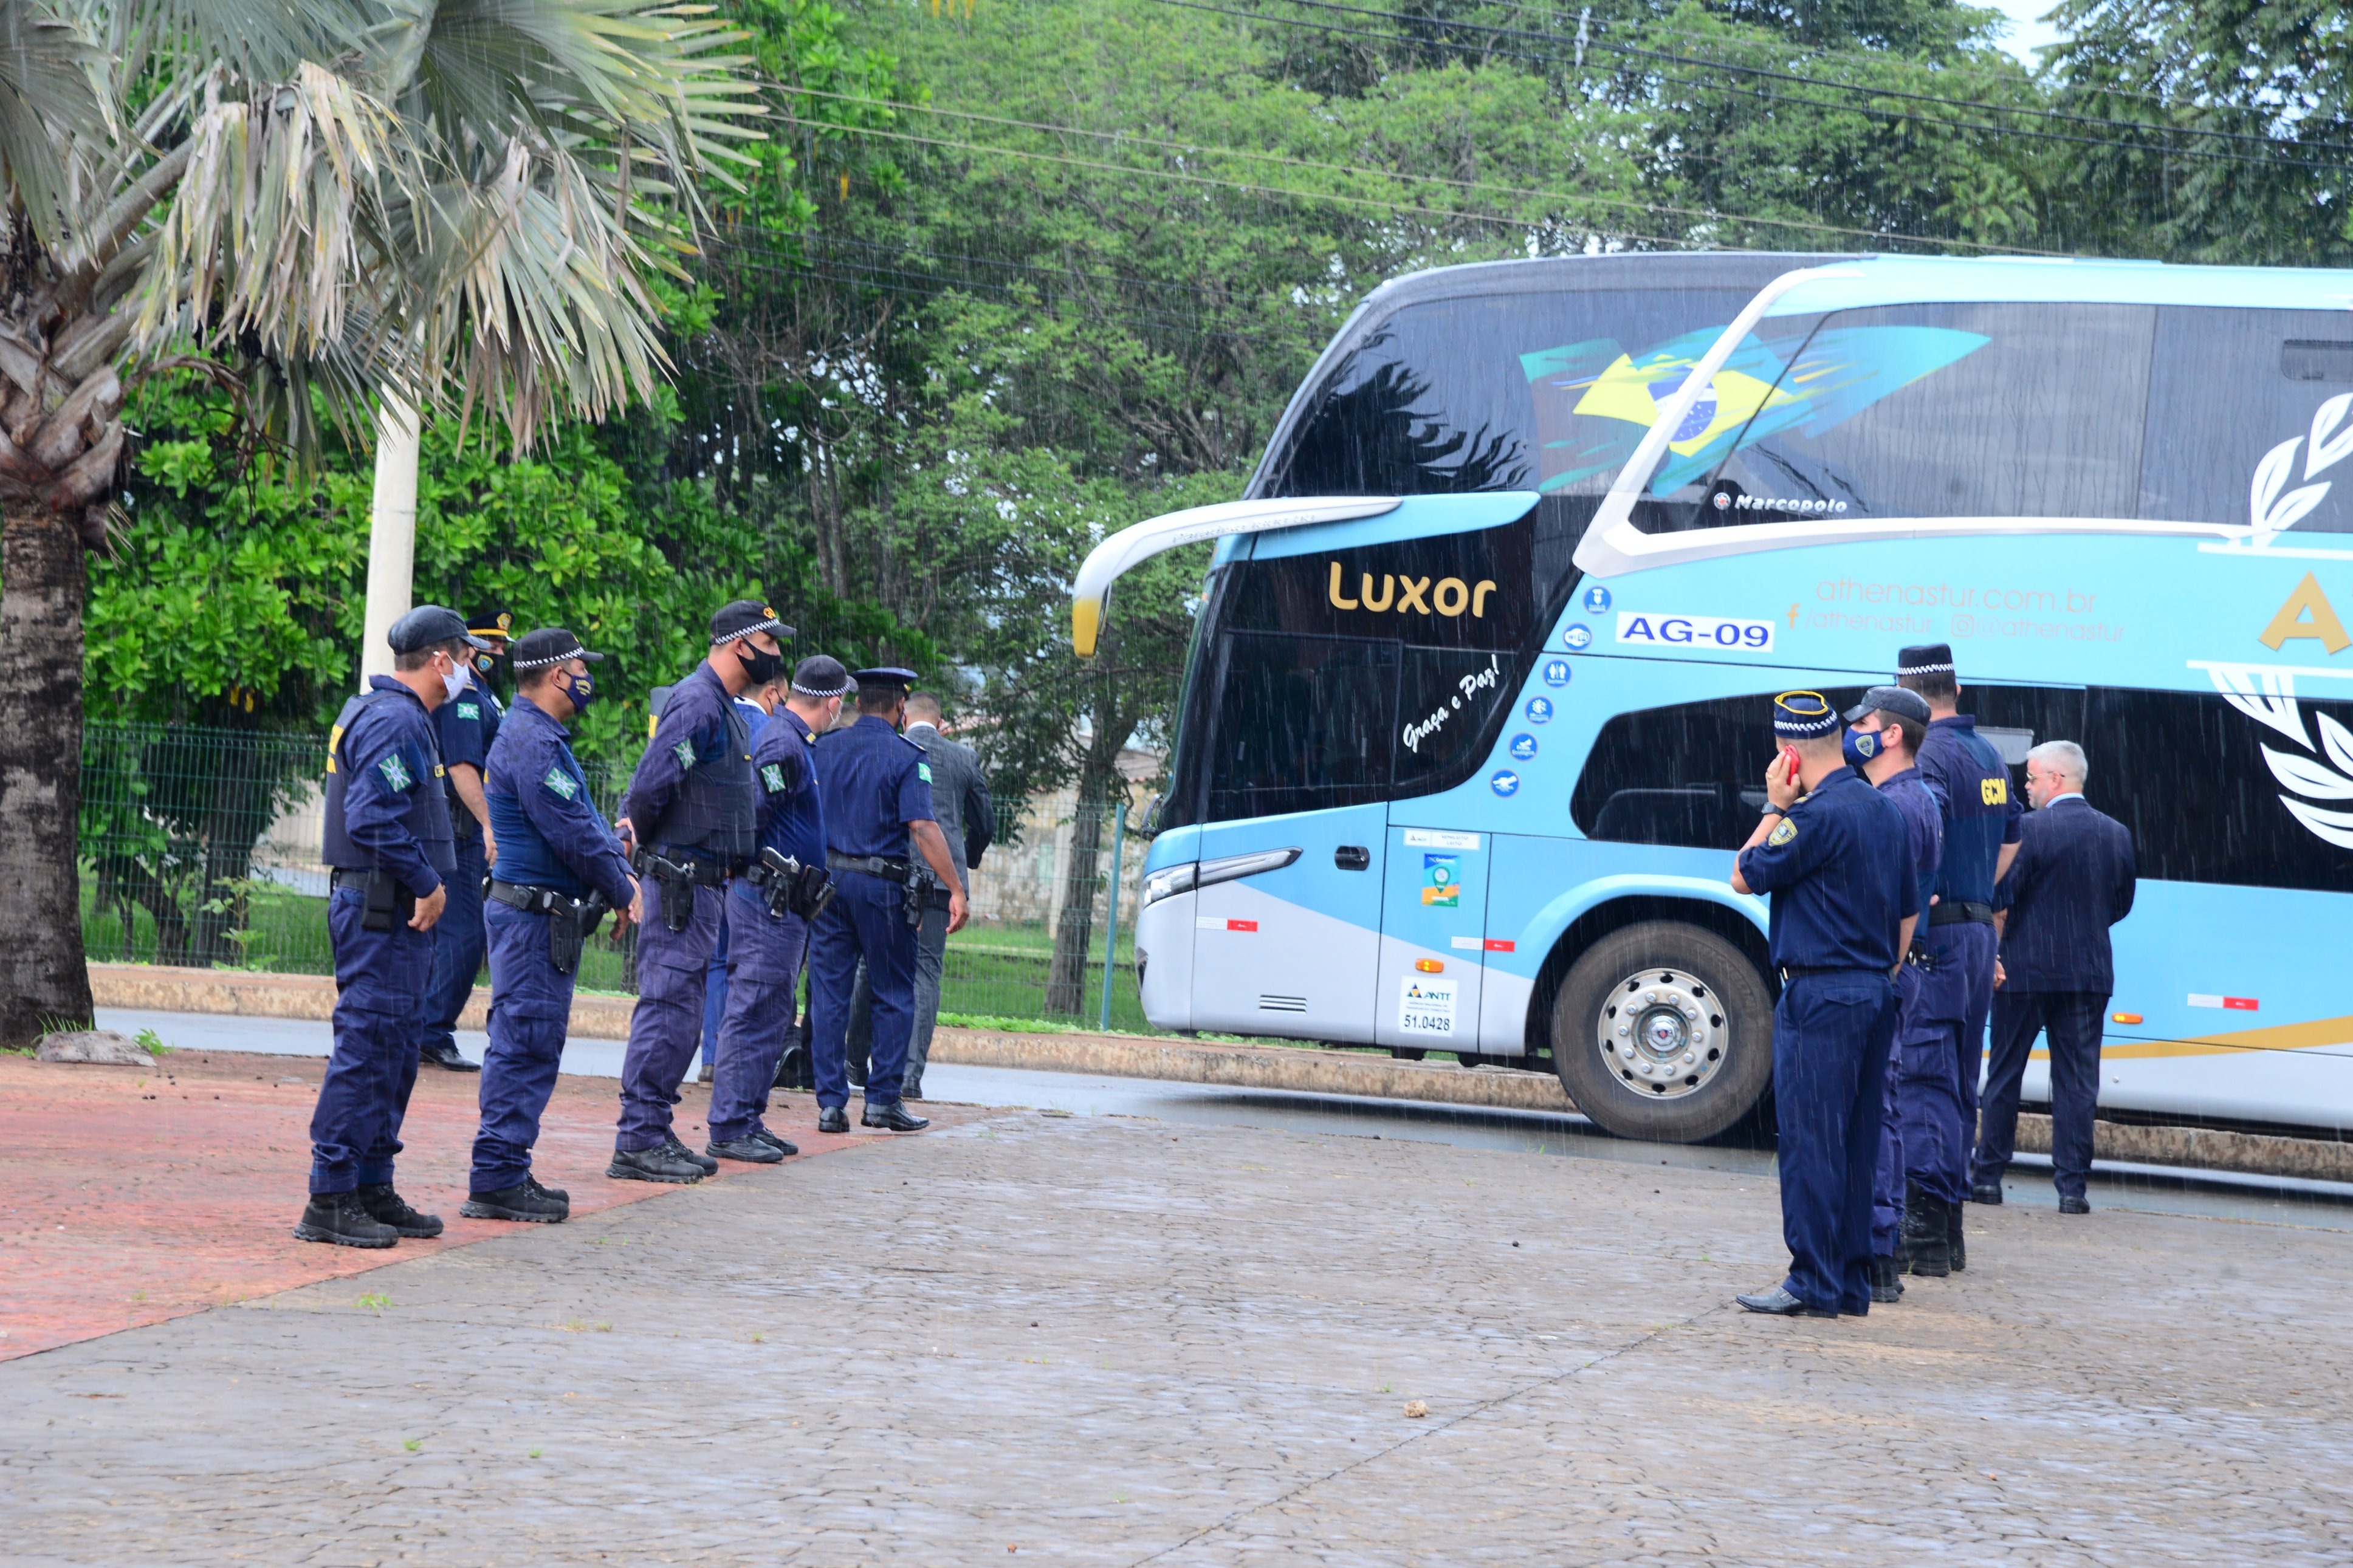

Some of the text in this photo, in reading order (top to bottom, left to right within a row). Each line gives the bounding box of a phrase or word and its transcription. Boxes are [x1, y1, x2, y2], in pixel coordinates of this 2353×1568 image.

[1734, 488, 1847, 513] Marcopolo
[1816, 576, 2097, 614] athenastur.com.br
[1623, 617, 1768, 647] AG-09
[1403, 654, 1500, 753] Graça e Paz!
[1424, 991, 1451, 1001] ANTT
[1404, 1014, 1450, 1031] 51.0428
